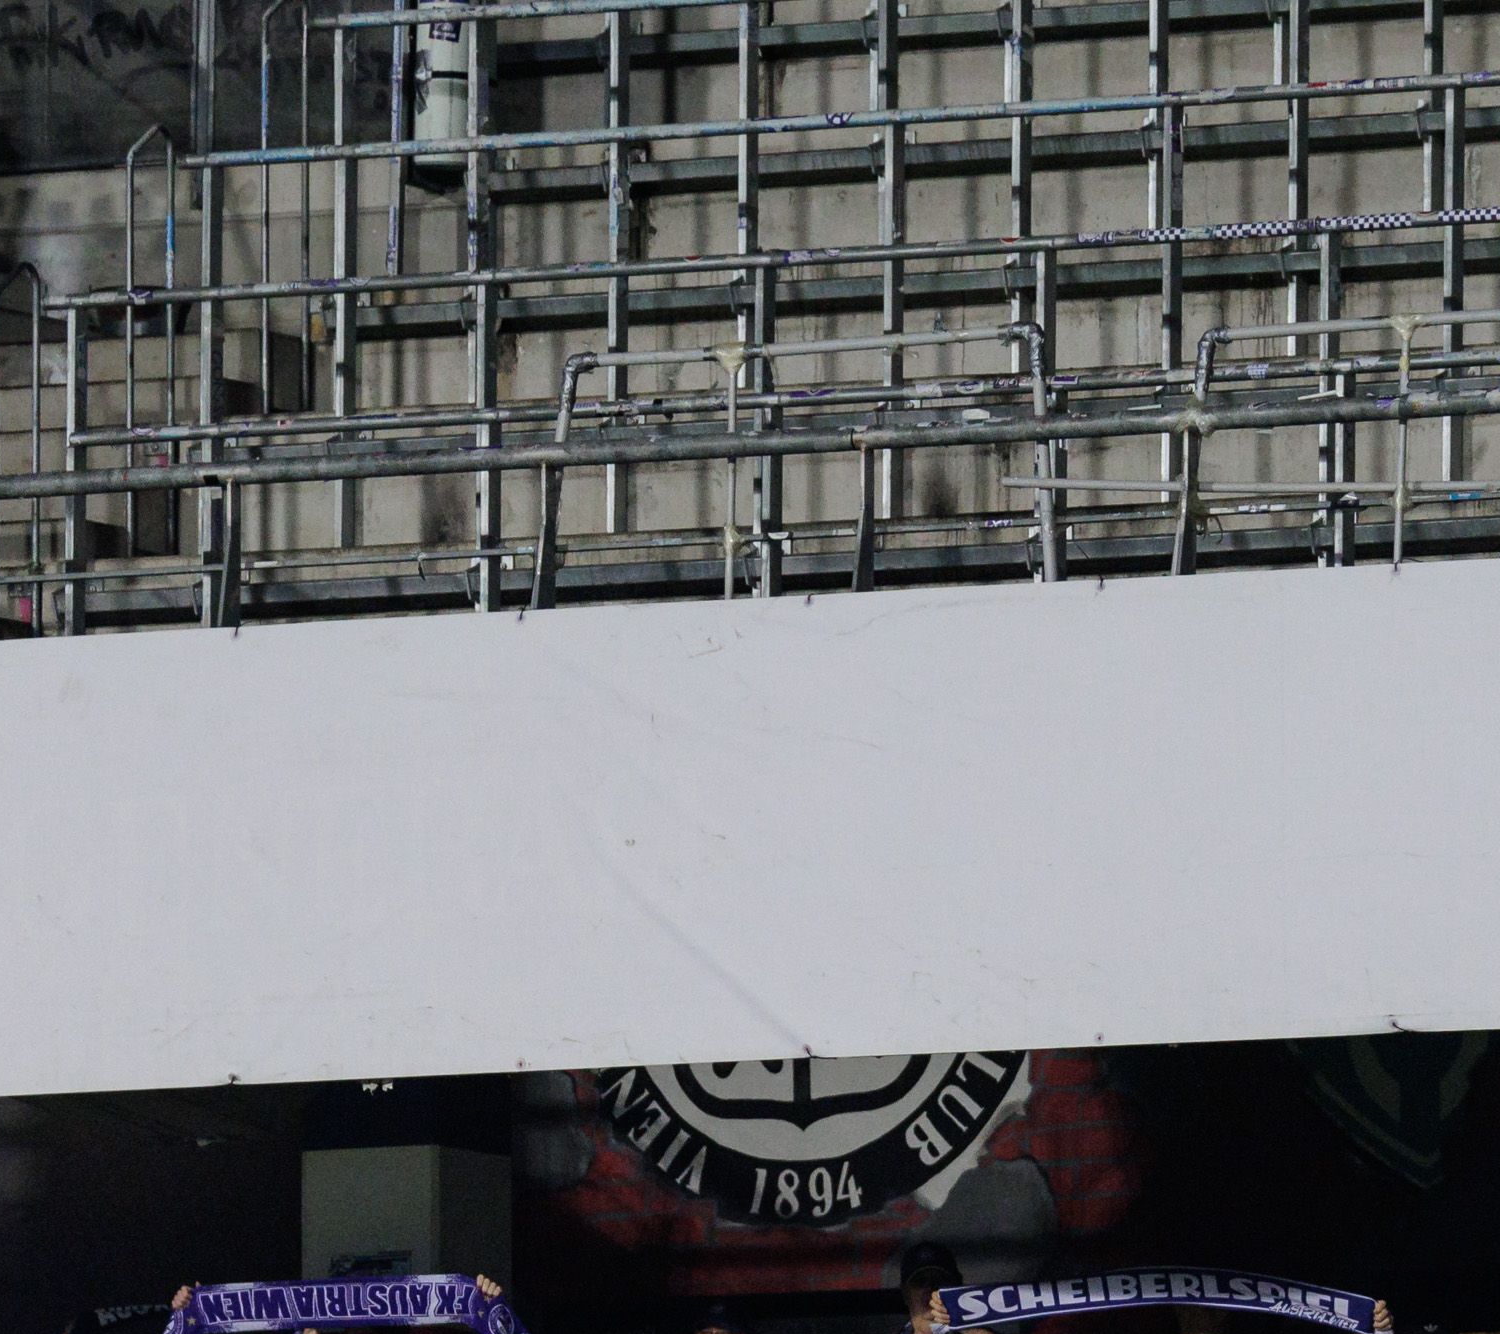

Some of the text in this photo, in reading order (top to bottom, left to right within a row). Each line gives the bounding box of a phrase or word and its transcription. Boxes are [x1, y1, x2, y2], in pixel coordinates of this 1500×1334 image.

[601, 1067, 708, 1196] VIEN
[748, 1160, 863, 1217] 1894
[200, 1283, 295, 1326] WIEN
[299, 1281, 432, 1321] AUSTRIA
